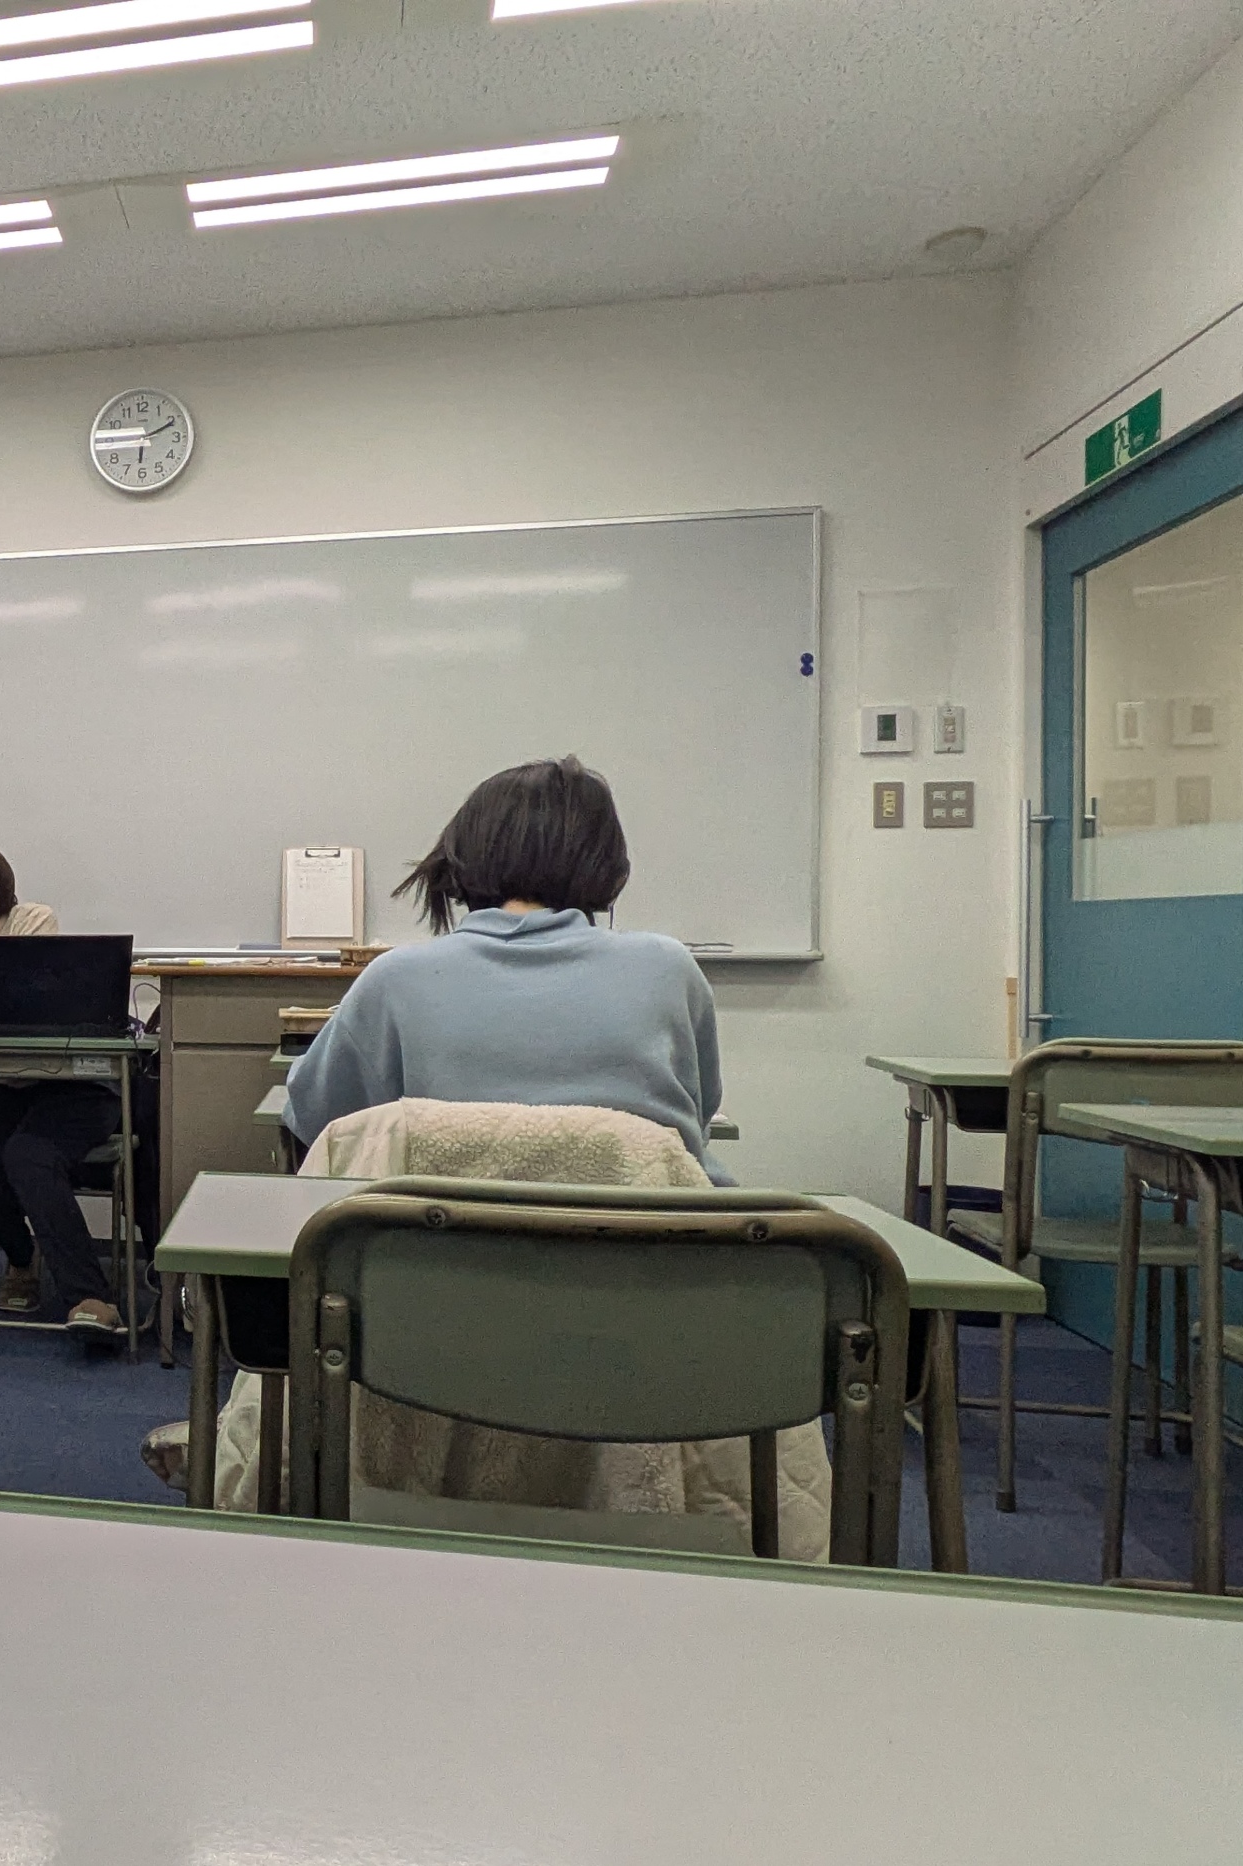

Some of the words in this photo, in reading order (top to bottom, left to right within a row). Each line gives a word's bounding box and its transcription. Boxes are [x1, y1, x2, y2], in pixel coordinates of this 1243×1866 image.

[122, 407, 131, 418] 11
[136, 402, 149, 412] 12
[156, 405, 161, 416] 1
[109, 420, 121, 429] 10
[168, 416, 175, 426] 2
[172, 432, 180, 443] 3
[110, 453, 119, 464] 8
[166, 450, 175, 459] 4
[123, 464, 131, 475] 7
[154, 462, 163, 473] 5
[138, 468, 147, 479] 6
